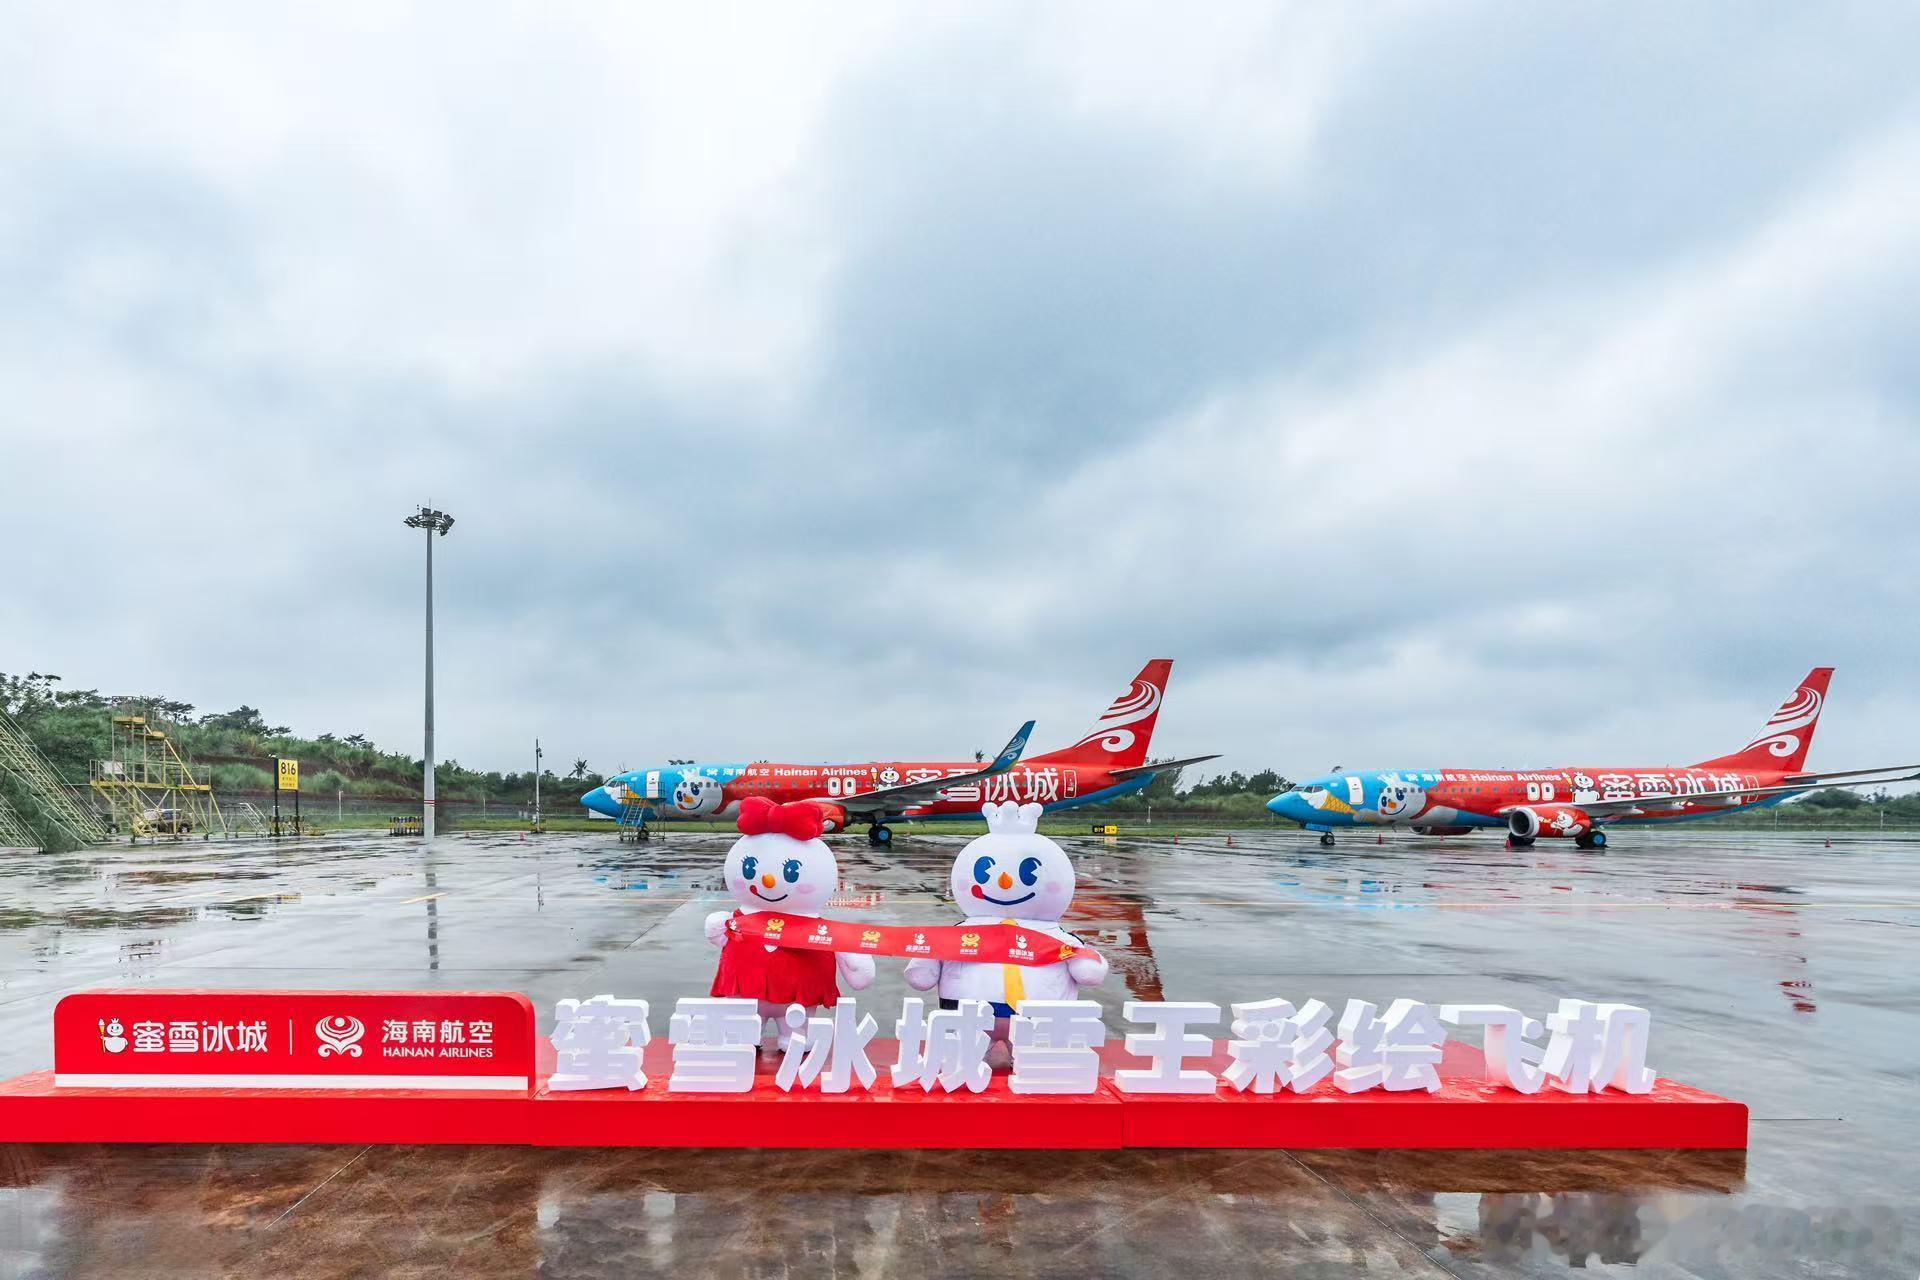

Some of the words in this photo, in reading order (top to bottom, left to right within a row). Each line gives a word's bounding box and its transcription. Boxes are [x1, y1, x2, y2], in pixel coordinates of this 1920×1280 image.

[281, 762, 296, 775] 816
[774, 768, 817, 776] Hainan
[821, 768, 867, 776] Airlines
[1471, 773, 1514, 782] Hainan
[1518, 773, 1562, 781] Airlines
[132, 1020, 268, 1053] 蜜雪冰城
[381, 1019, 494, 1044] 海南航空
[548, 994, 1657, 1095] 蜜雪冰城雪王彩绘飞机
[382, 1047, 434, 1058] HAINAN
[438, 1047, 493, 1058] AIRLINES
